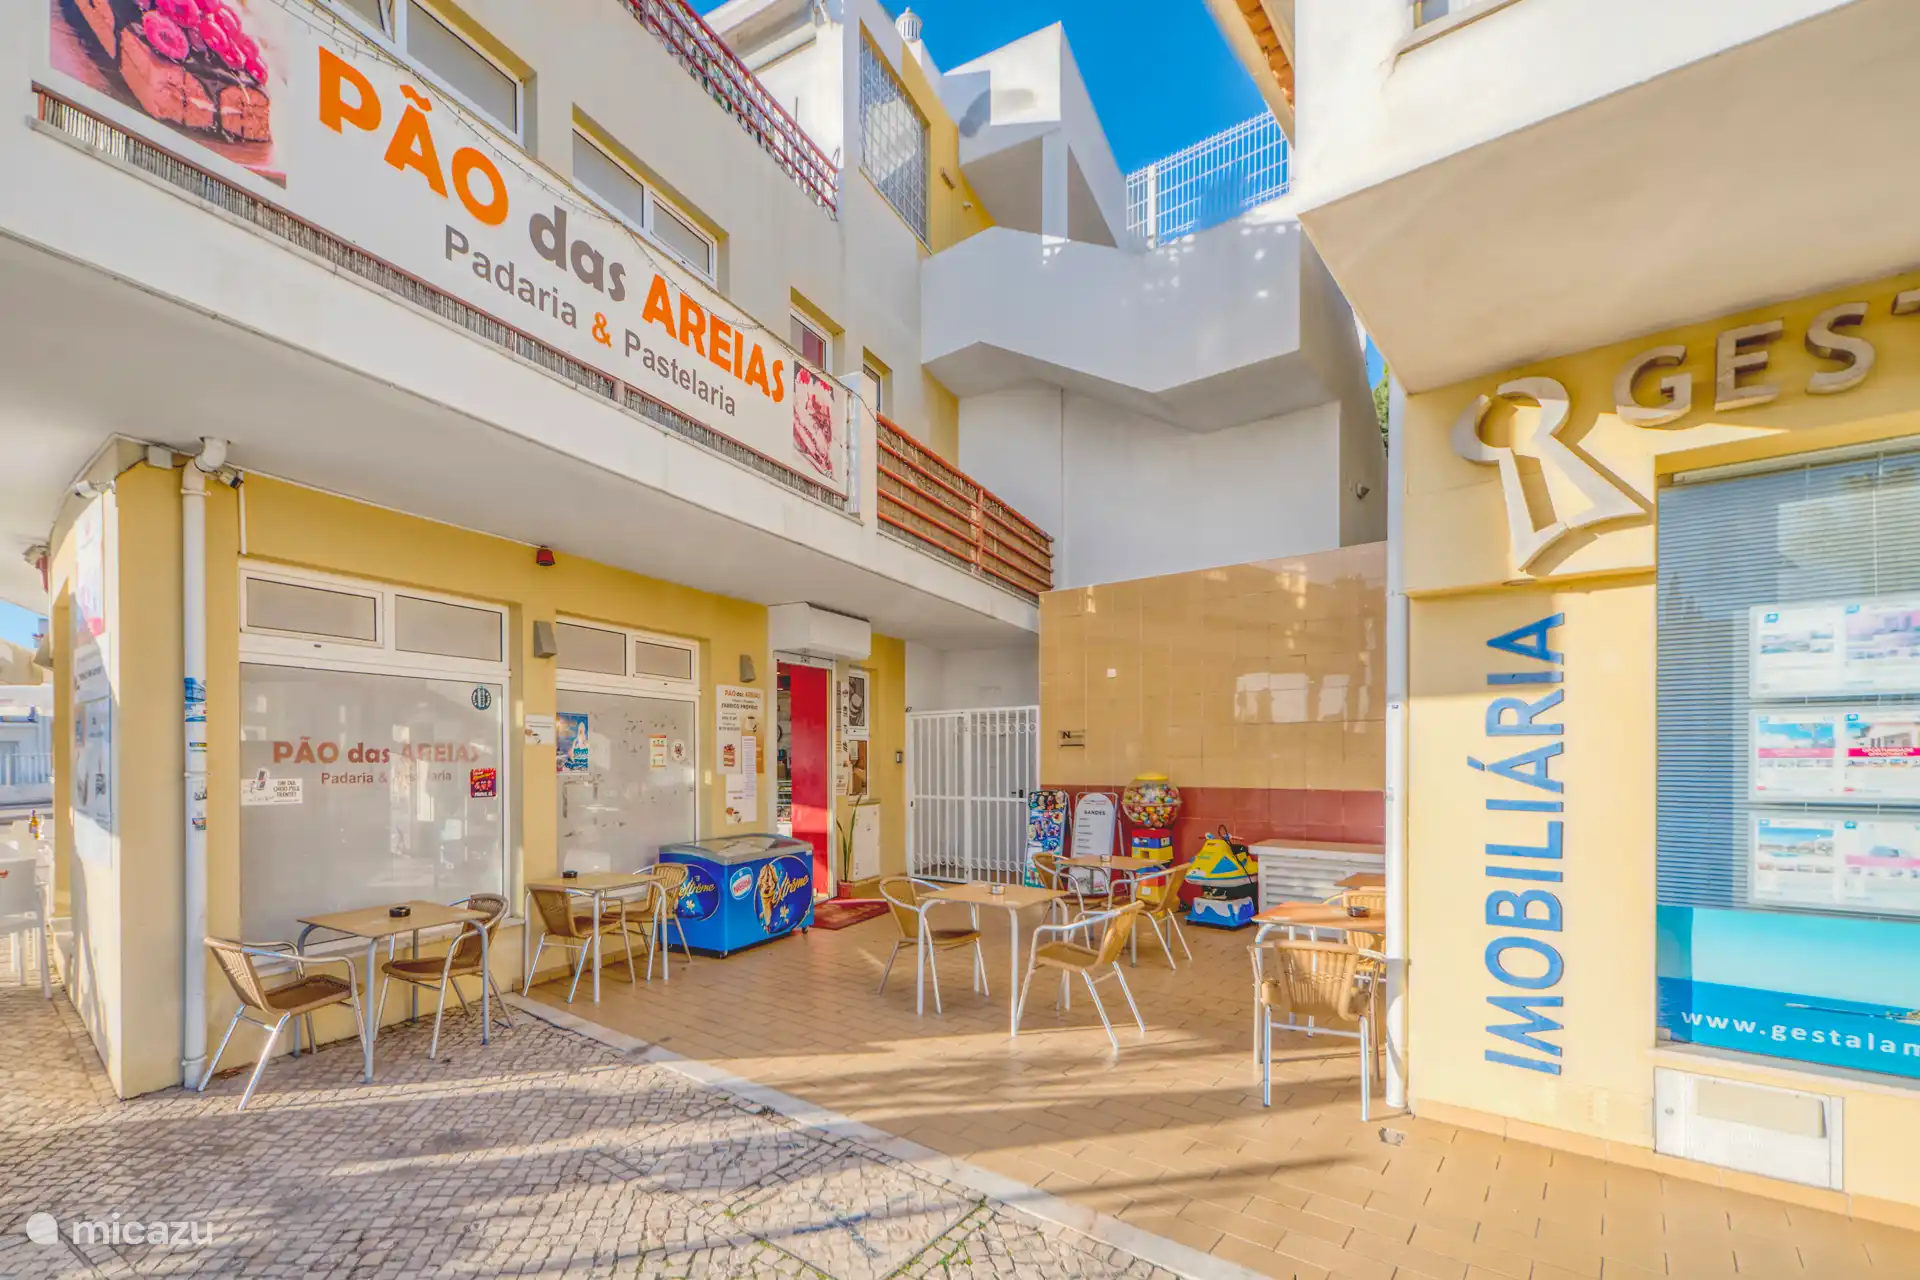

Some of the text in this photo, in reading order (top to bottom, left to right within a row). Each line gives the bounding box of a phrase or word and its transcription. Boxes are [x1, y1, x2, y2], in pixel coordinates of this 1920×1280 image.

[319, 45, 785, 403] PÃO das AREIAS
[444, 224, 737, 417] Padaria & Pastelaria
[273, 736, 339, 764] PÃO
[347, 741, 390, 764] das
[321, 772, 374, 785] Padaria
[1467, 612, 1565, 1076] IMOBILIÁRIA
